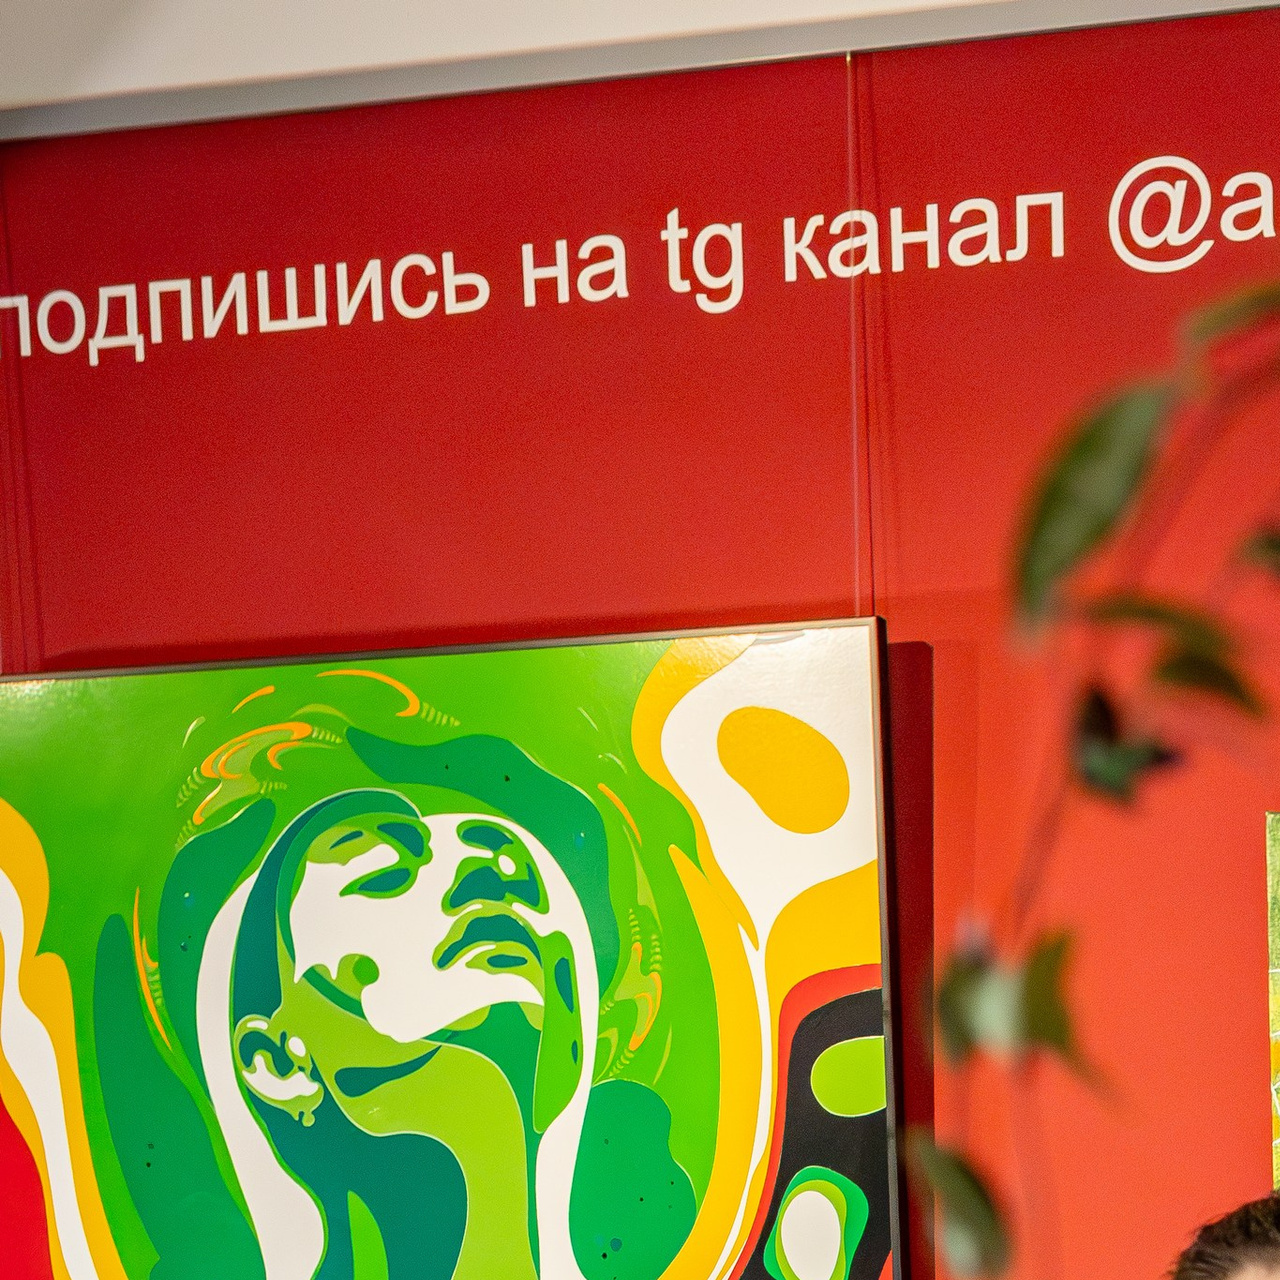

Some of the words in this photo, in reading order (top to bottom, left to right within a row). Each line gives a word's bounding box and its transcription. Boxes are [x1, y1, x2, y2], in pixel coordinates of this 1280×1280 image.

[0, 251, 492, 368] подпишись
[520, 234, 631, 309] на
[660, 207, 744, 314] tg
[782, 191, 1066, 284] канал
